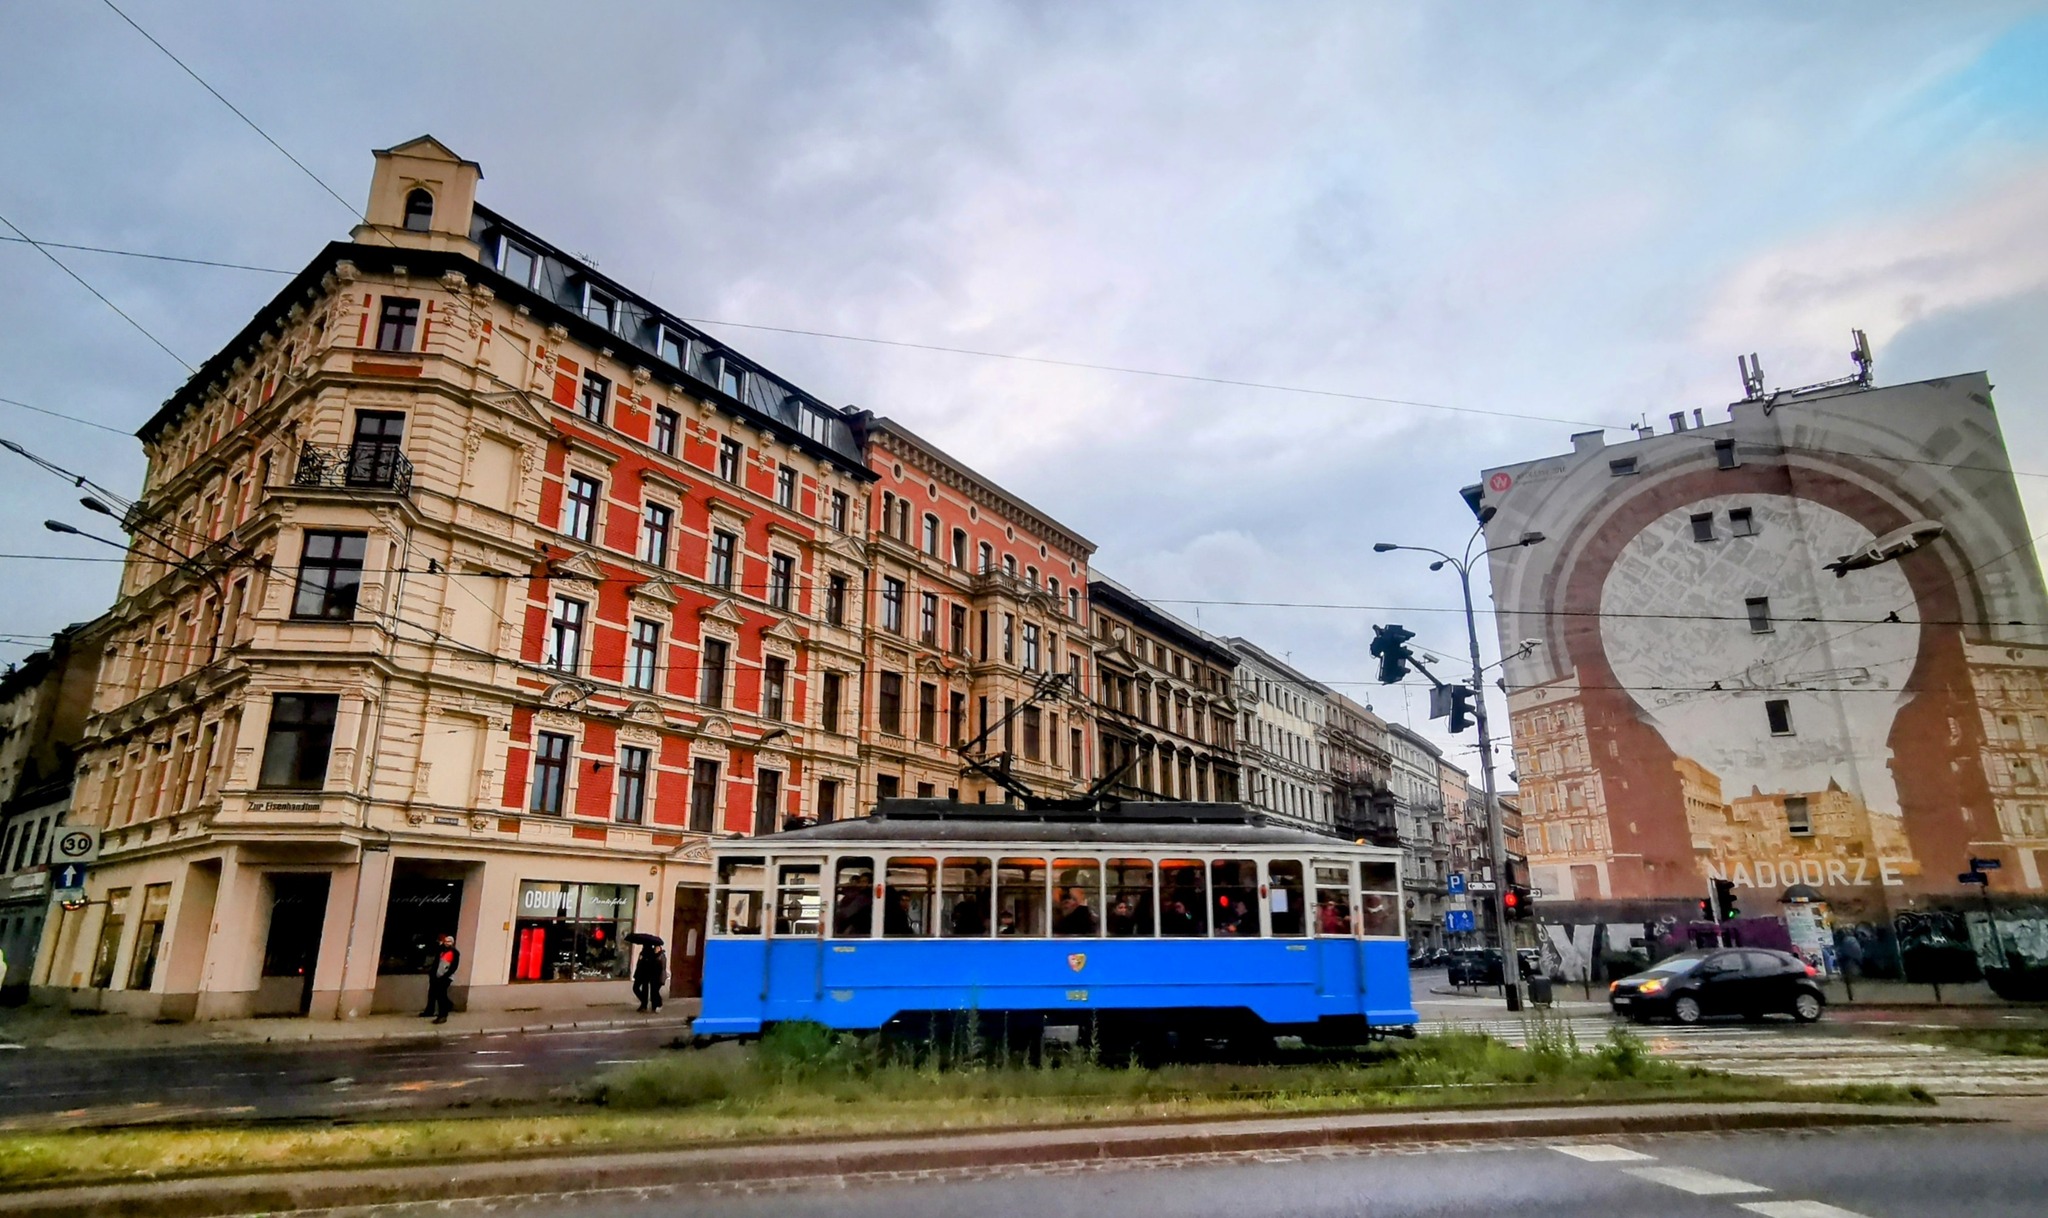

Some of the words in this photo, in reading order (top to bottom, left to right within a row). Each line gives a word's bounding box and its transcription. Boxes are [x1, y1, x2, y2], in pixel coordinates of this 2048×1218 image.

[65, 838, 88, 851] 30
[1705, 855, 1905, 889] NADODRZE
[1450, 875, 1460, 888] P
[524, 890, 573, 910] OBUWIE
